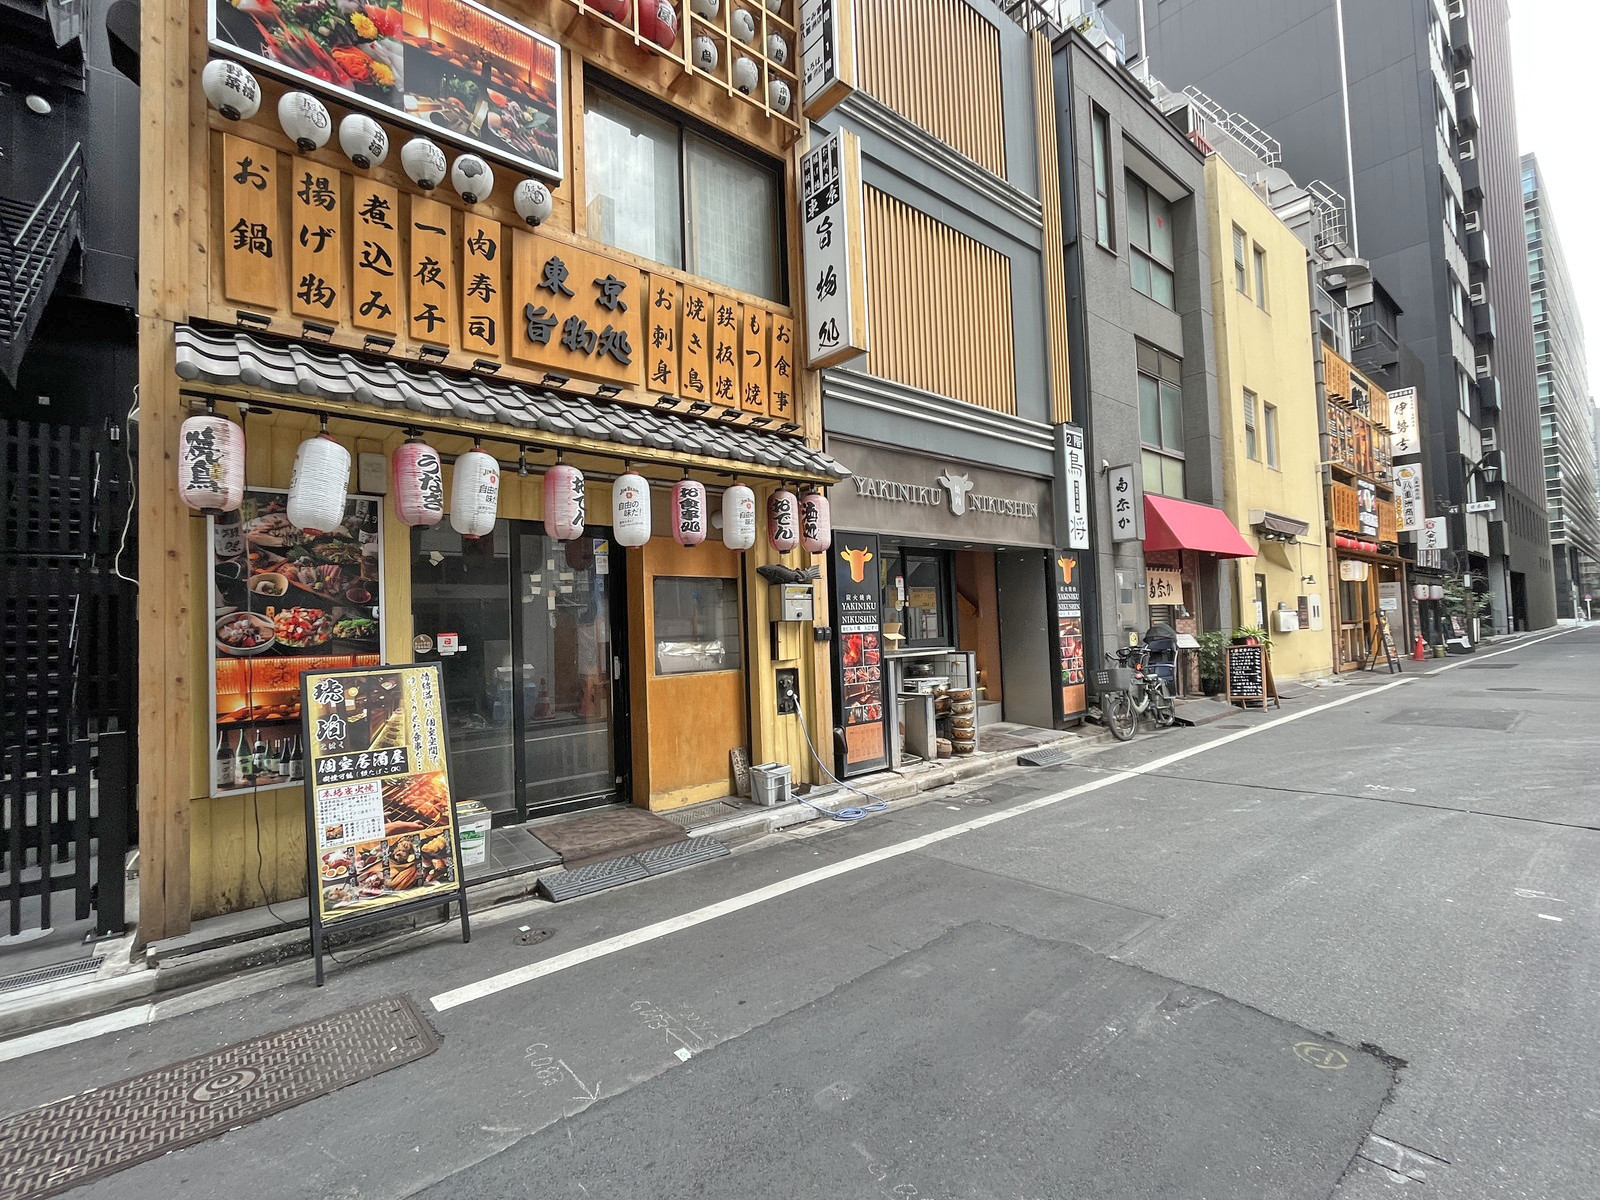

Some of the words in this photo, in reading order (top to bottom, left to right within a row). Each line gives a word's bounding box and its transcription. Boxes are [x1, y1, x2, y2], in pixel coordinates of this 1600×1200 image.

[230, 156, 273, 258] お鍋
[808, 184, 839, 218] 東京
[297, 172, 336, 308] 揚げ物
[359, 194, 394, 319] 煮込み
[414, 221, 446, 333] 一夜干
[467, 229, 497, 346] 肉寿司
[537, 255, 628, 312] 東京
[816, 215, 840, 352] 旨物処
[525, 302, 632, 365] 旨物処
[651, 287, 673, 385] お刺身
[684, 295, 707, 394] 焼き鳥
[715, 304, 736, 400] 鉄板焼
[744, 313, 762, 407] もつ焼
[773, 323, 791, 412] お食事
[1066, 433, 1082, 449] 2階
[417, 454, 442, 511] うなぎ
[679, 487, 701, 532] お食事処
[772, 498, 793, 540] おでん
[851, 475, 942, 506] YAKINIKU
[969, 494, 1038, 518] NIKUSHIN
[841, 602, 877, 610] YAKINIKU
[841, 615, 877, 624] NIKUSHIN
[318, 749, 406, 774] 個室居酒屋
